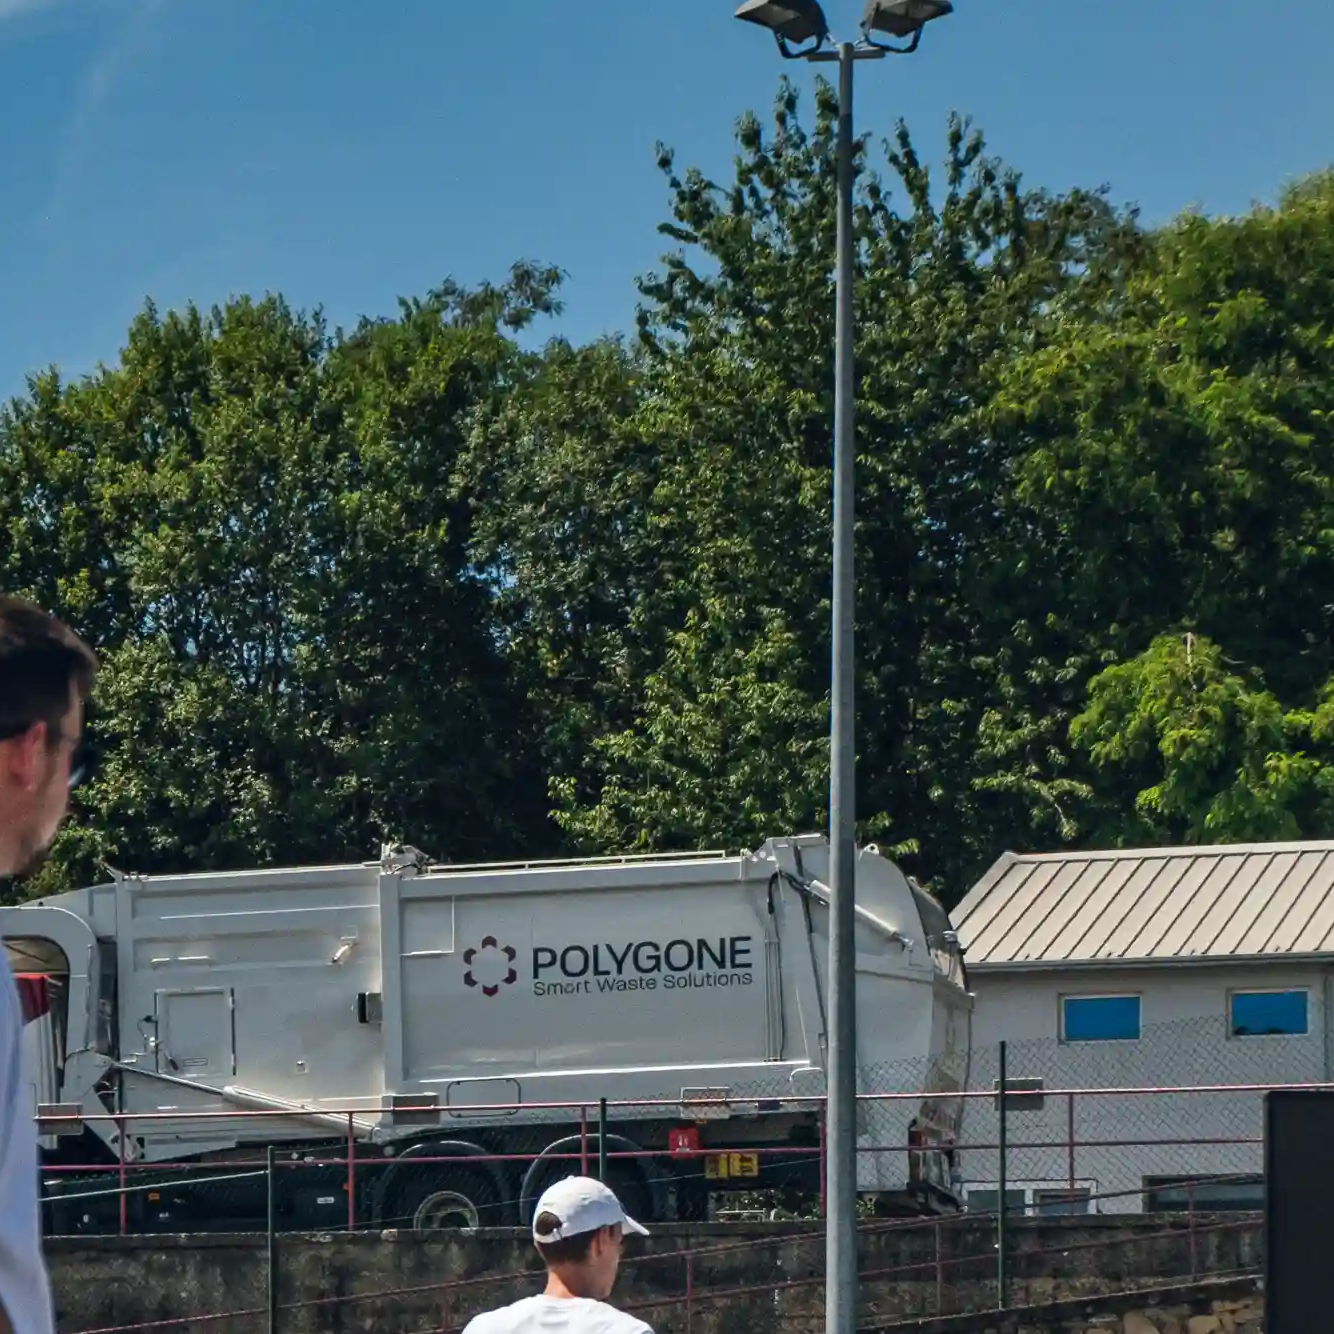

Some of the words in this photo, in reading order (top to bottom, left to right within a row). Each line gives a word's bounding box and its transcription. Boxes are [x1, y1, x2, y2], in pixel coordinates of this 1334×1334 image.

[532, 935, 754, 980] POLYGONE
[533, 980, 592, 997] Smart
[596, 976, 657, 993] Waste
[663, 971, 754, 990] Solutions
